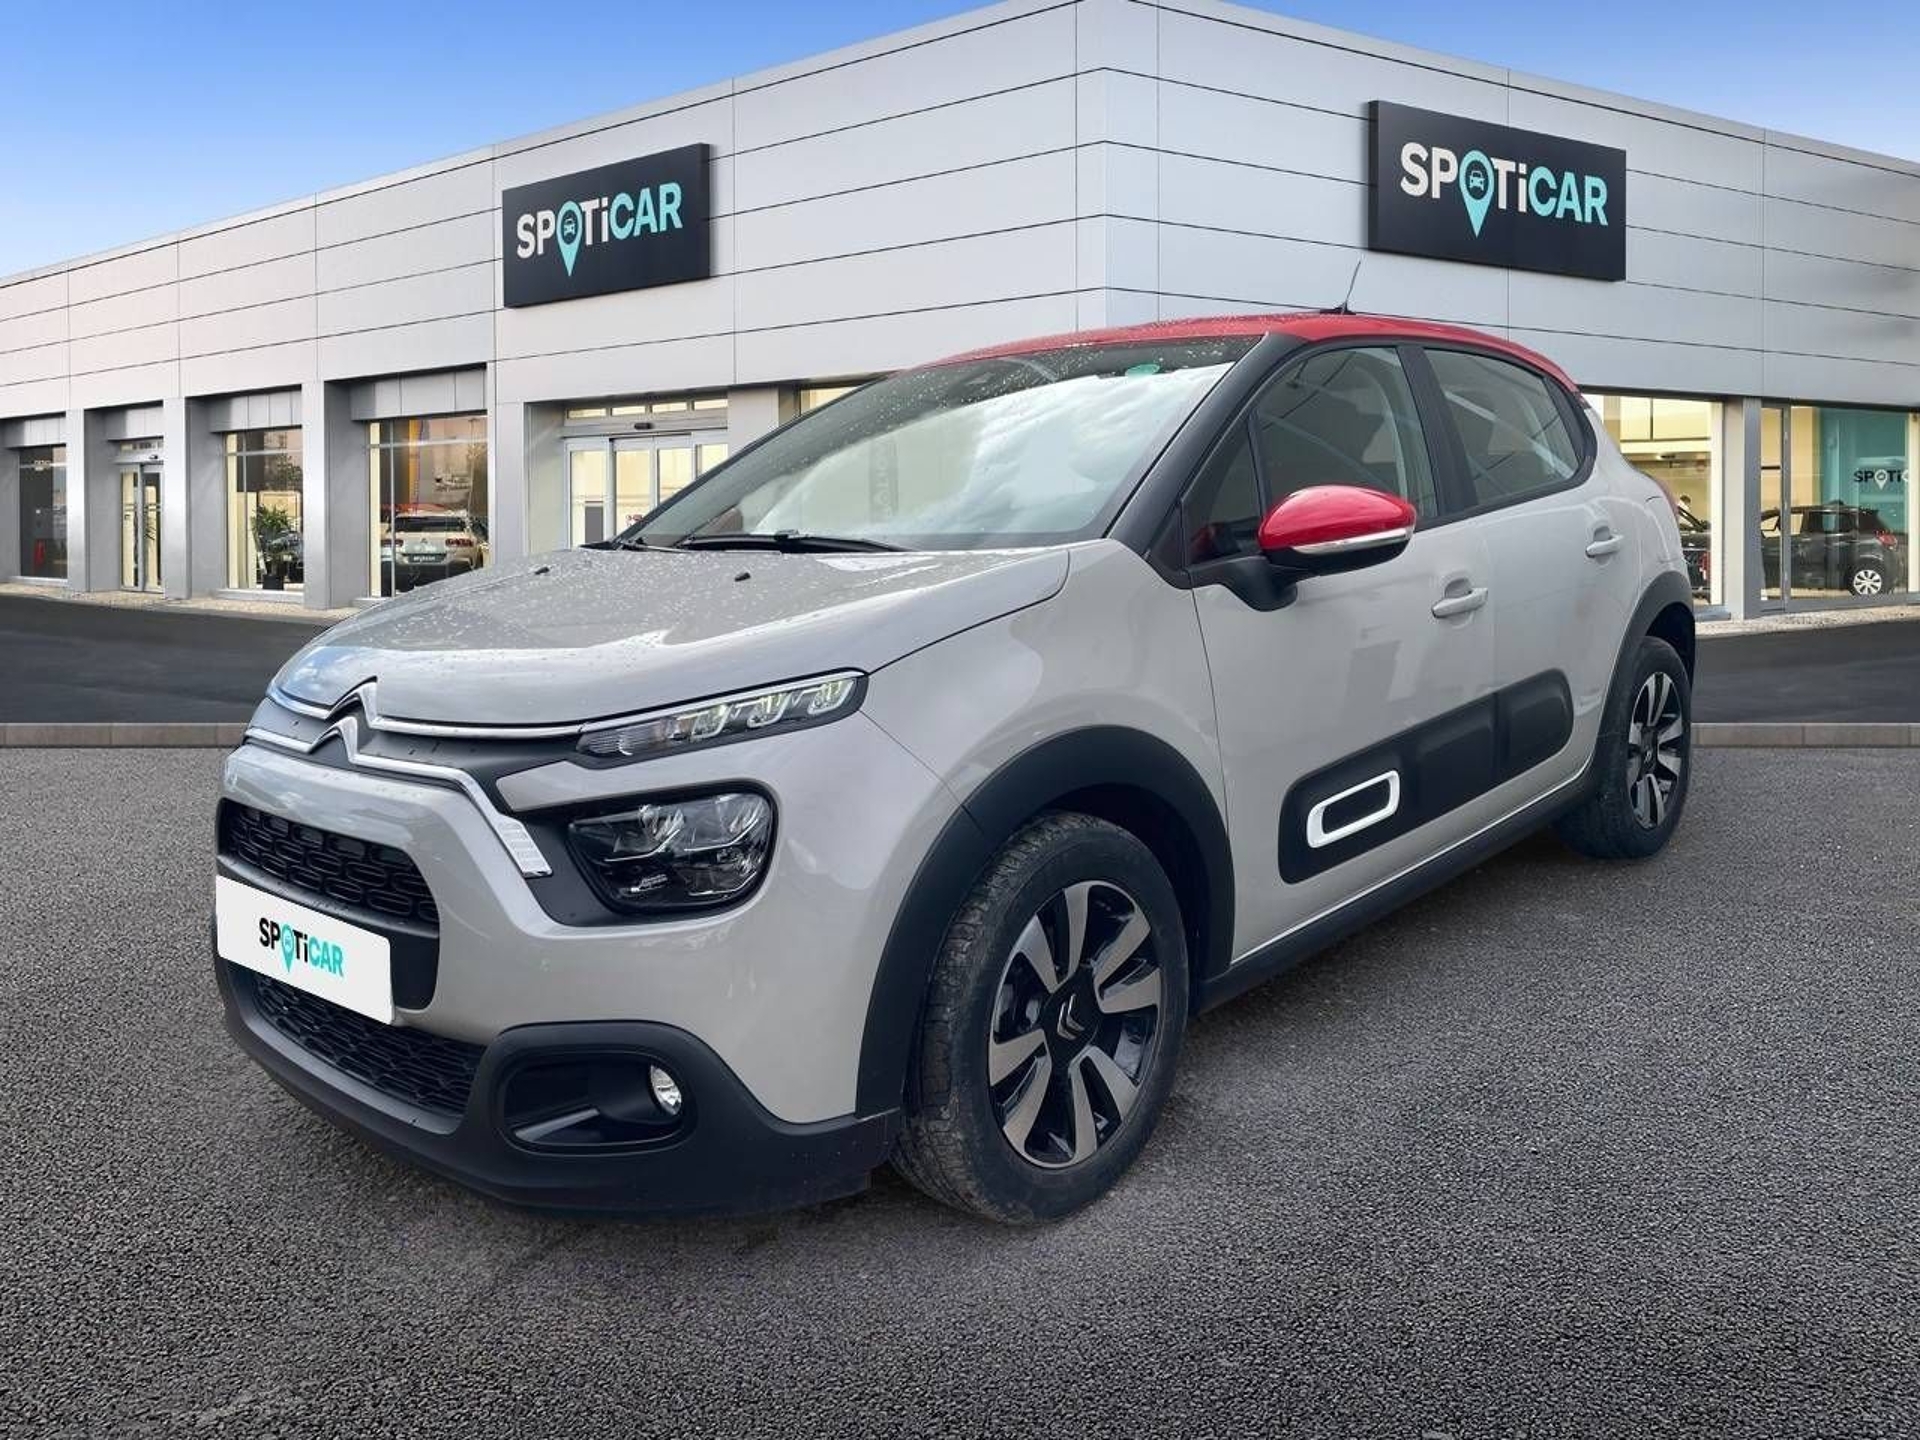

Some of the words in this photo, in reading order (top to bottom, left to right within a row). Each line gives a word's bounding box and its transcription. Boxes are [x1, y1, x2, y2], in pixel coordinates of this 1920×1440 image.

[516, 182, 683, 277] SPOTiCAR
[1400, 142, 1609, 238] SPOTiCAR
[259, 917, 344, 977] SPOTiCAR
